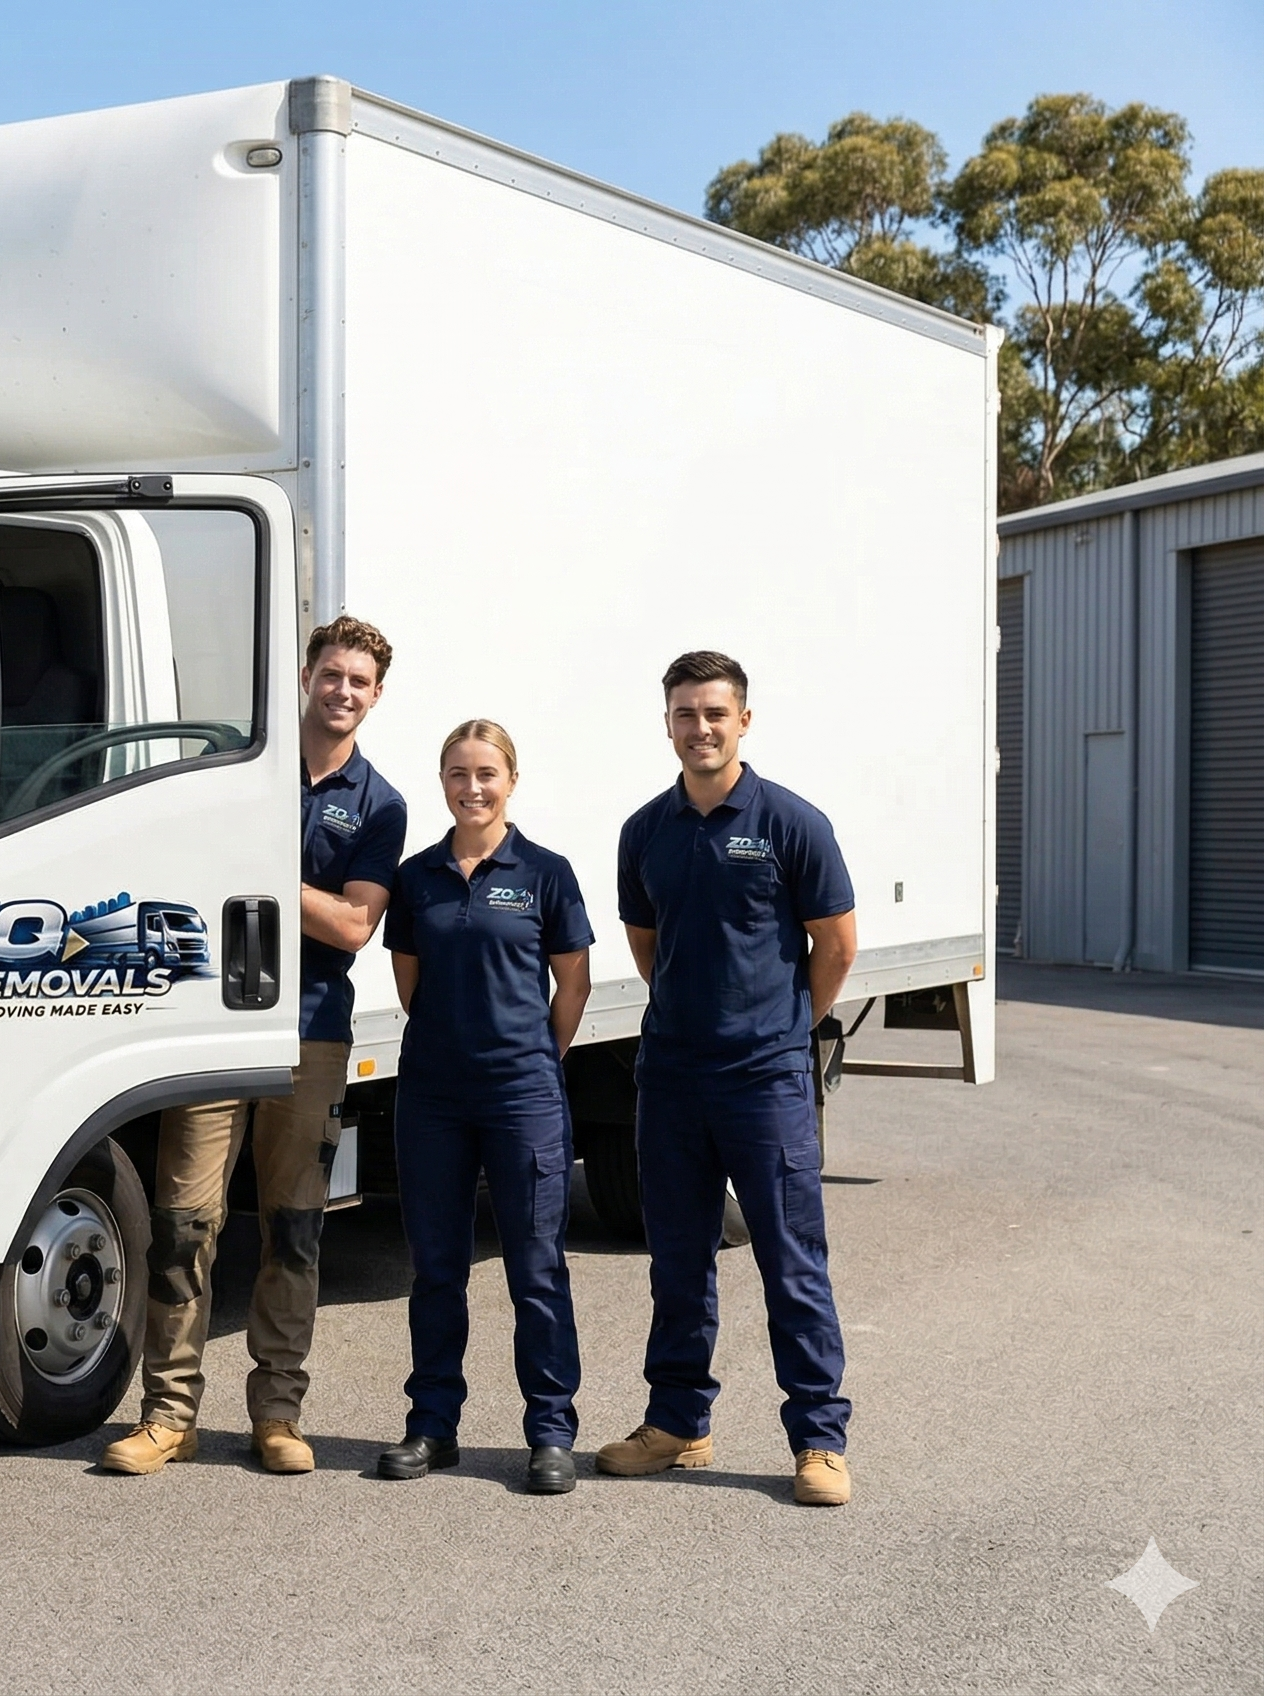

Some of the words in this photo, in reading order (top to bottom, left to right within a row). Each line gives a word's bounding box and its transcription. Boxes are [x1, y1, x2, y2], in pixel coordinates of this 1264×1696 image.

[726, 836, 753, 849] ZO
[486, 887, 515, 900] ZO
[50, 1004, 97, 1017] MADE
[101, 1002, 145, 1016] EASY
